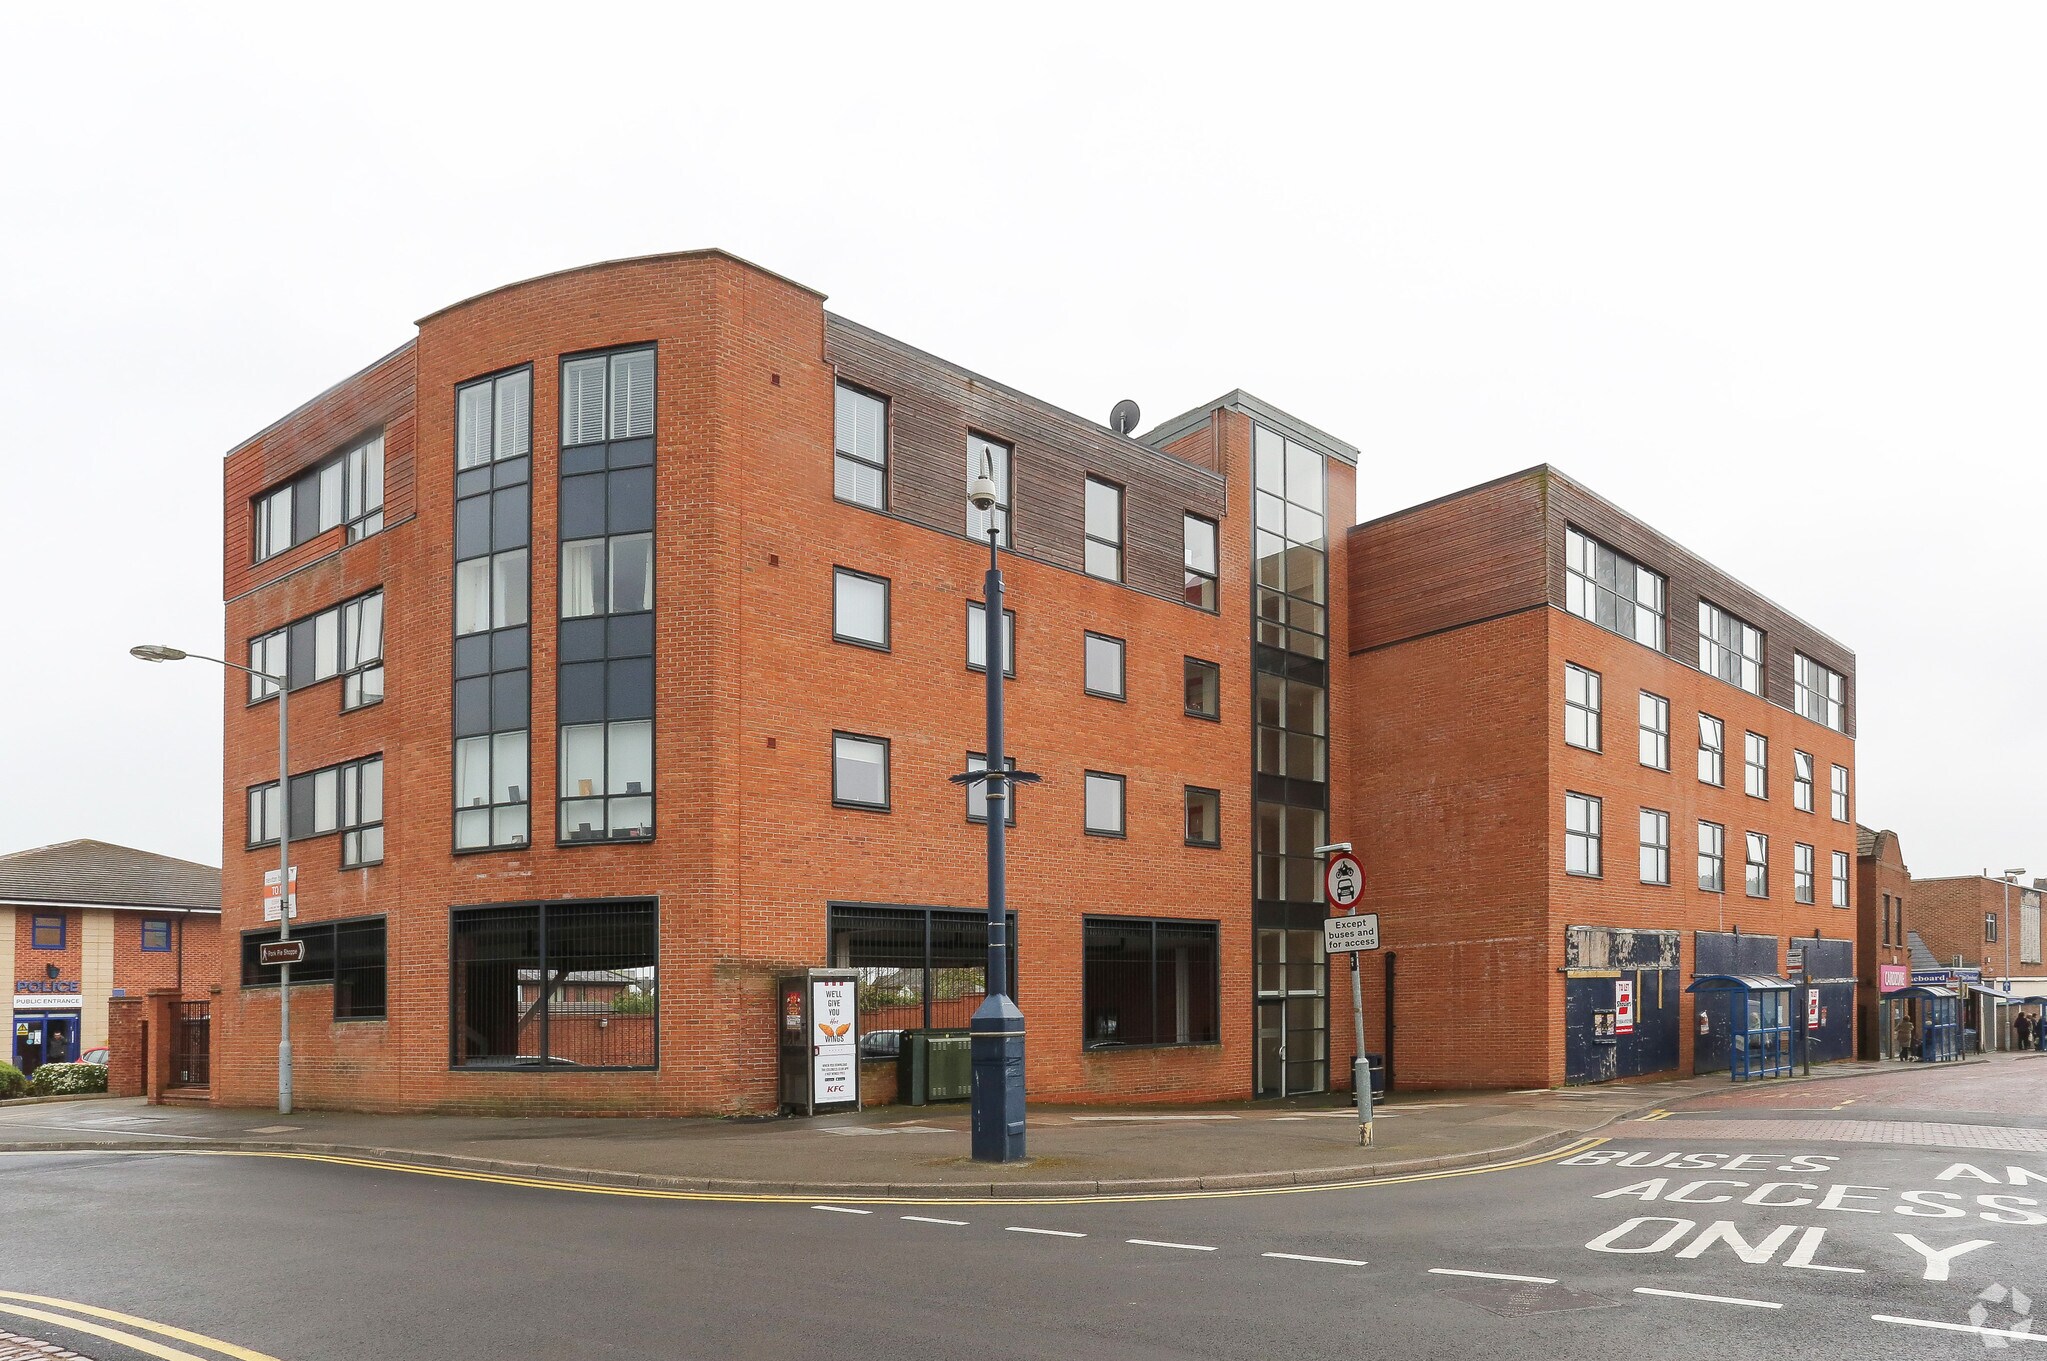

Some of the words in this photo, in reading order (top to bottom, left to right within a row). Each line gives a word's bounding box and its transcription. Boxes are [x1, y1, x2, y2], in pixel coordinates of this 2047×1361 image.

[272, 886, 279, 895] TO
[1335, 919, 1366, 929] Except
[1329, 931, 1354, 939] buses
[1357, 928, 1374, 936] and
[1329, 940, 1342, 949] for
[1345, 938, 1375, 947] access
[17, 981, 79, 992] POLICE
[825, 1035, 845, 1043] WINGS
[827, 1085, 844, 1093] KFC
[1557, 1150, 1841, 1173] BUSES
[1592, 1178, 2047, 1226] ACCESS
[1585, 1216, 1997, 1281] ONLY
